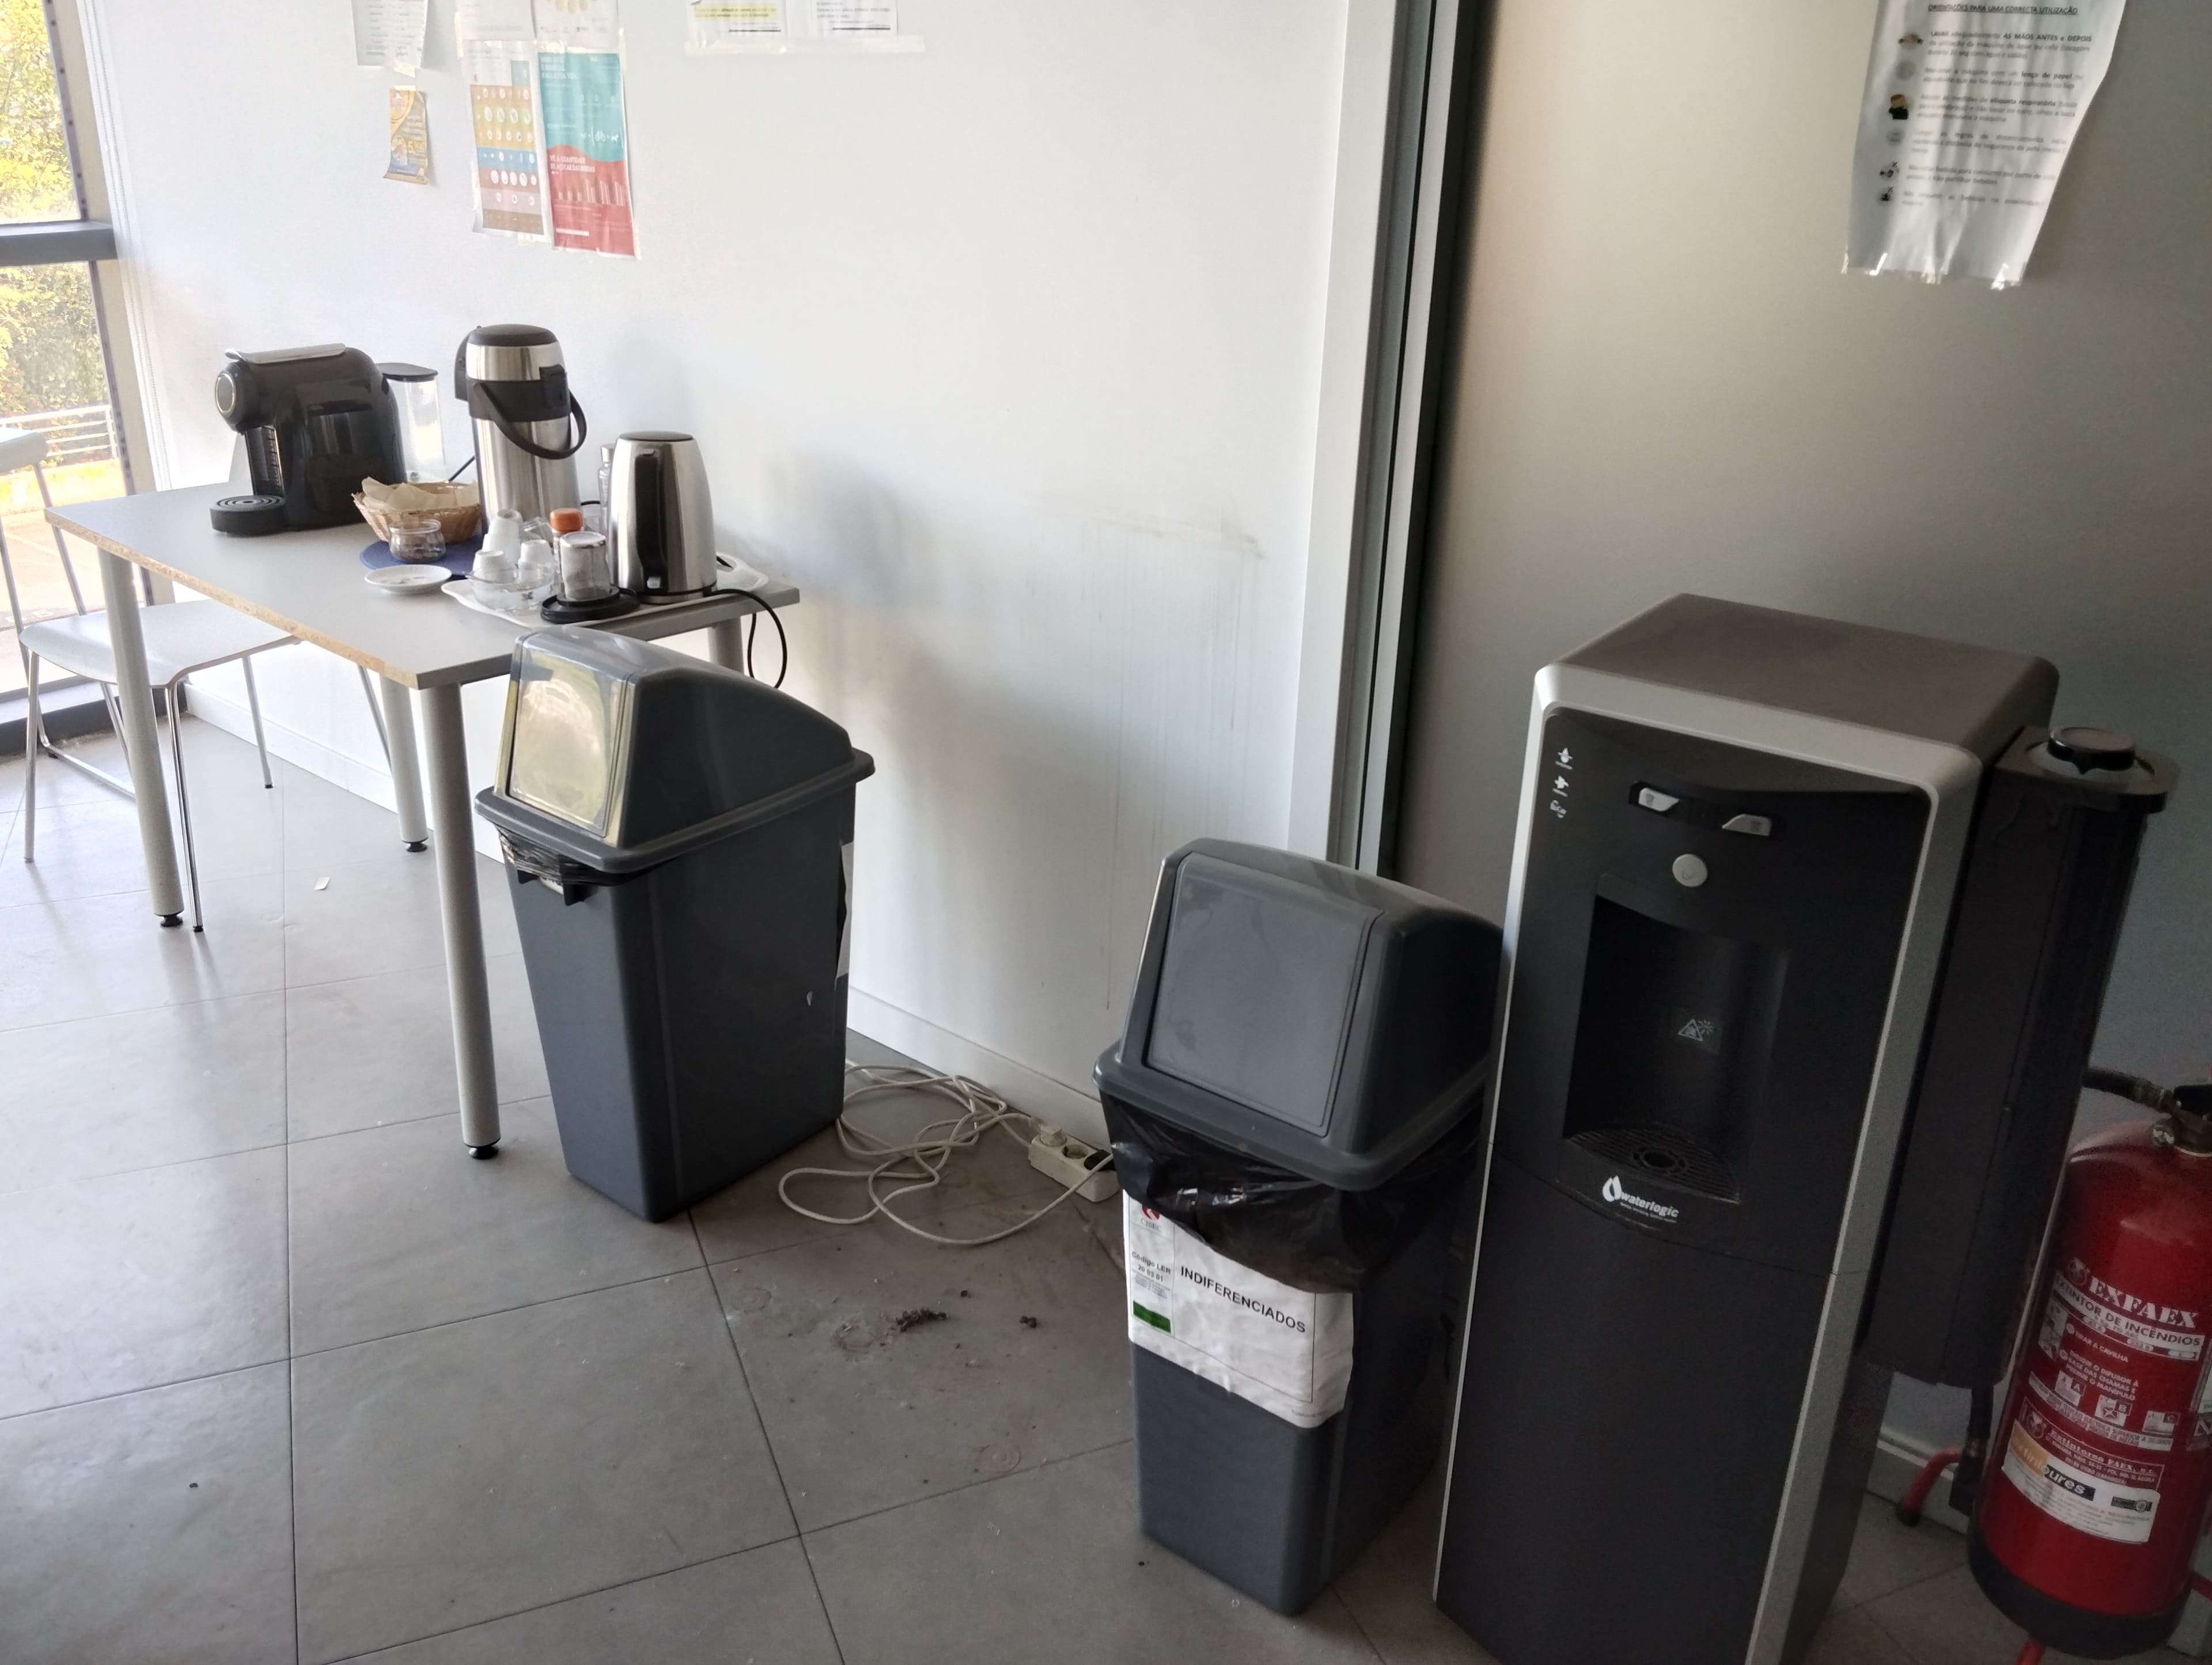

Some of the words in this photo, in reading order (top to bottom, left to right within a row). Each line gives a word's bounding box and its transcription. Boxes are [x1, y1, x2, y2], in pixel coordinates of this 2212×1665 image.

[1621, 1191, 1679, 1218] waterlogic
[1131, 1251, 1156, 1268] Código
[1181, 1265, 1306, 1333] INDIFERENCIADOS
[2088, 1276, 2199, 1329] EXFAEX
[2105, 1313, 2122, 1326] DE
[2125, 1321, 2200, 1346] INCÊNDIOS
[2118, 1404, 2127, 1414] B
